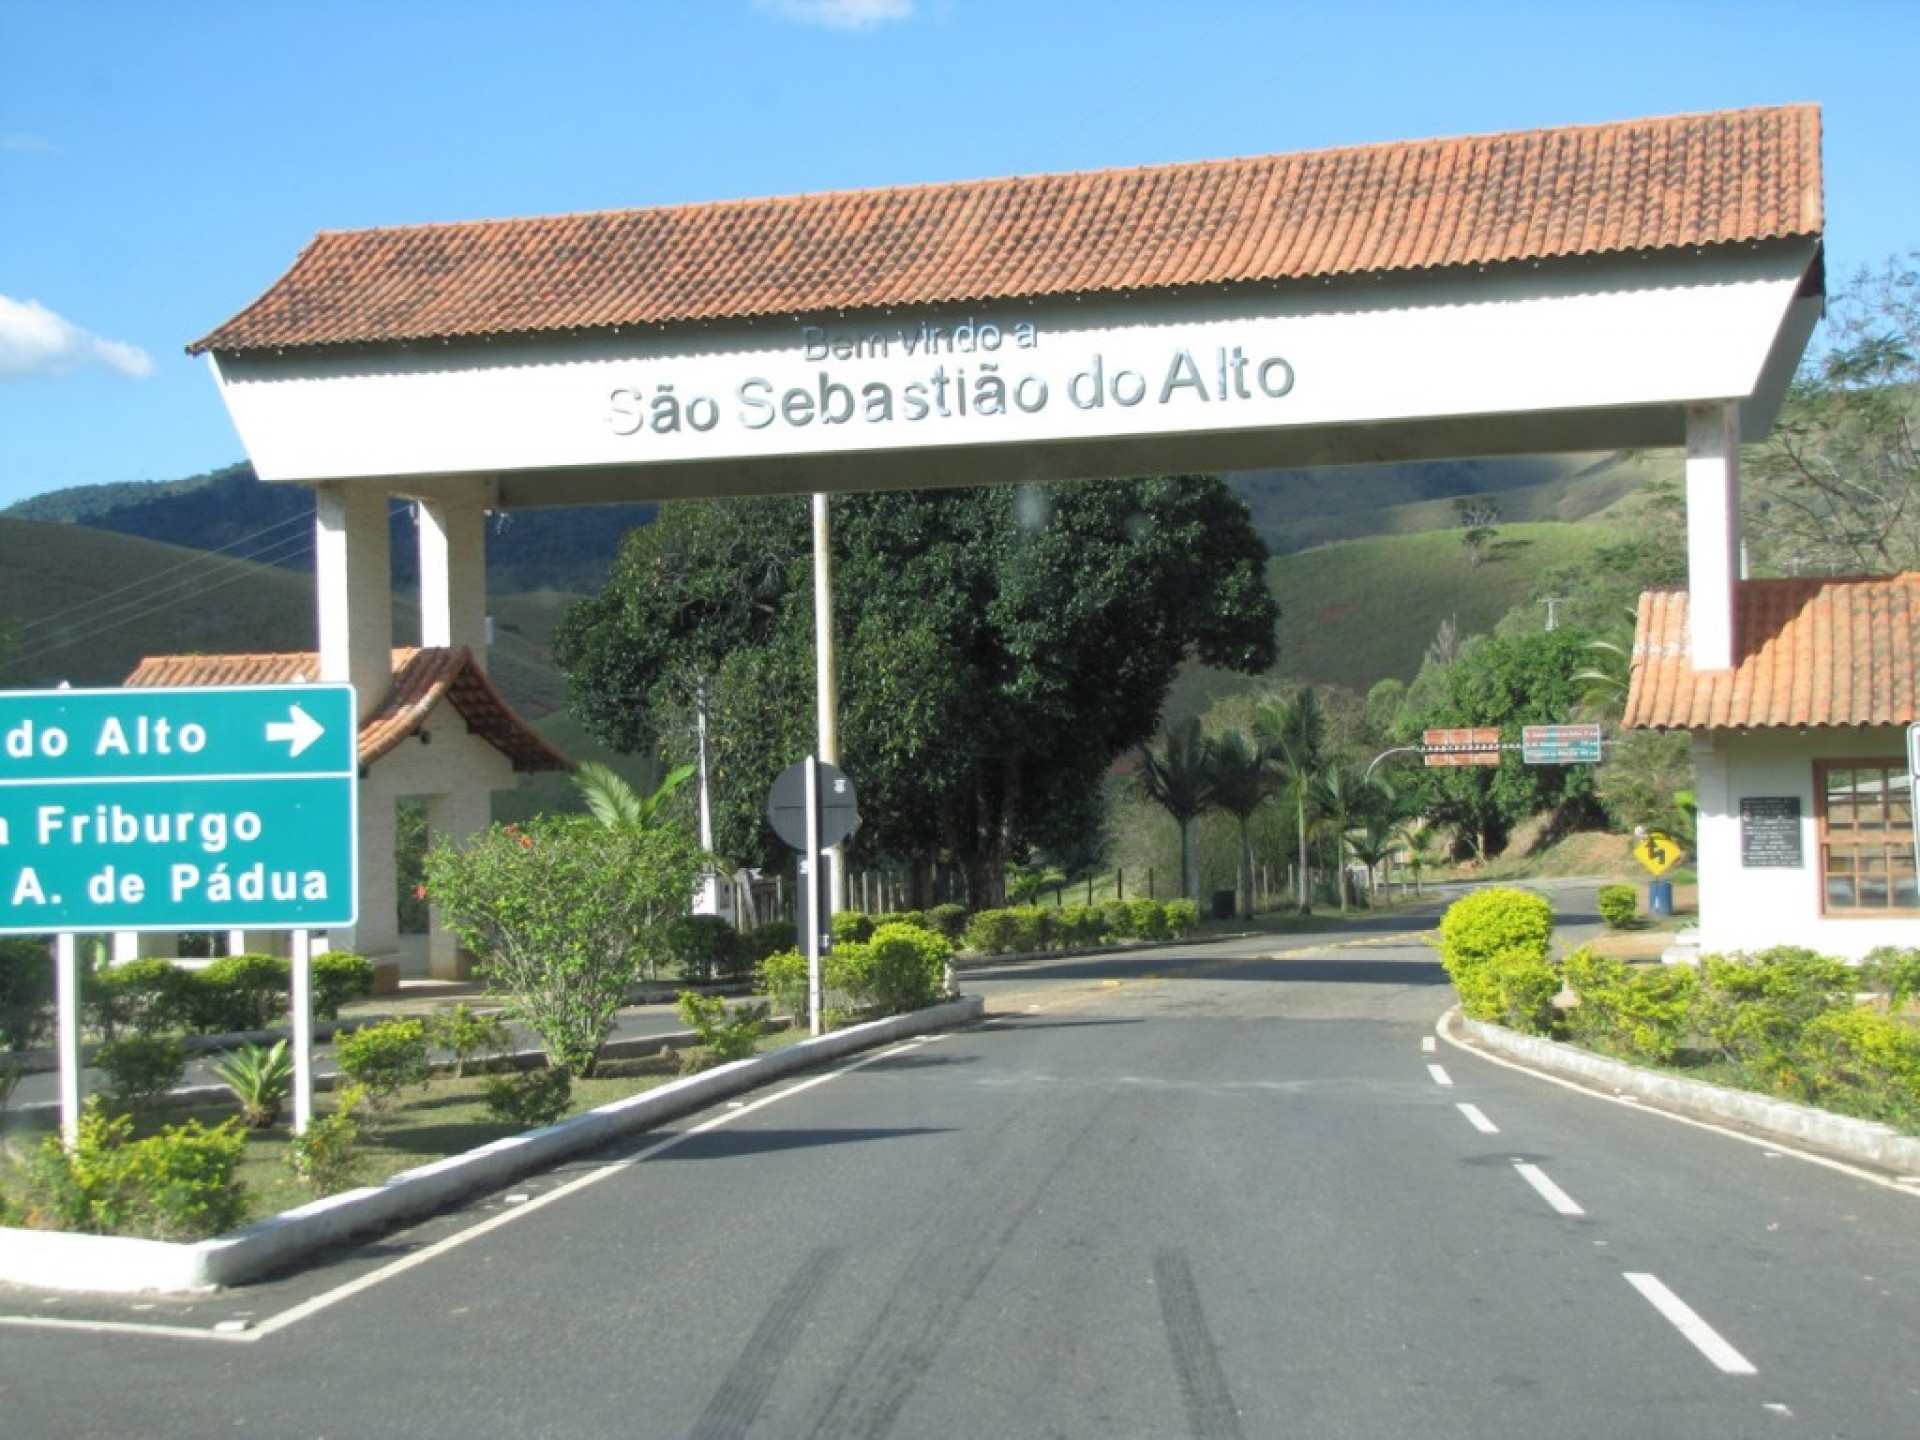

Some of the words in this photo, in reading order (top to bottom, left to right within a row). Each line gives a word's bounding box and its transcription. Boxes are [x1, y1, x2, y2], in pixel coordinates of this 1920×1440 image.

[802, 325, 890, 361] Bem
[897, 316, 1002, 357] vindo
[1013, 321, 1038, 350] a
[604, 383, 720, 436] São
[735, 363, 1049, 430] Sebastião
[1066, 353, 1147, 410] do
[1157, 345, 1296, 404] Alto
[5, 719, 69, 758] do
[94, 715, 208, 755] Alto
[37, 804, 263, 853] Friburgo
[10, 866, 63, 906] A.
[87, 864, 147, 904] de
[170, 862, 329, 903] Pádua
